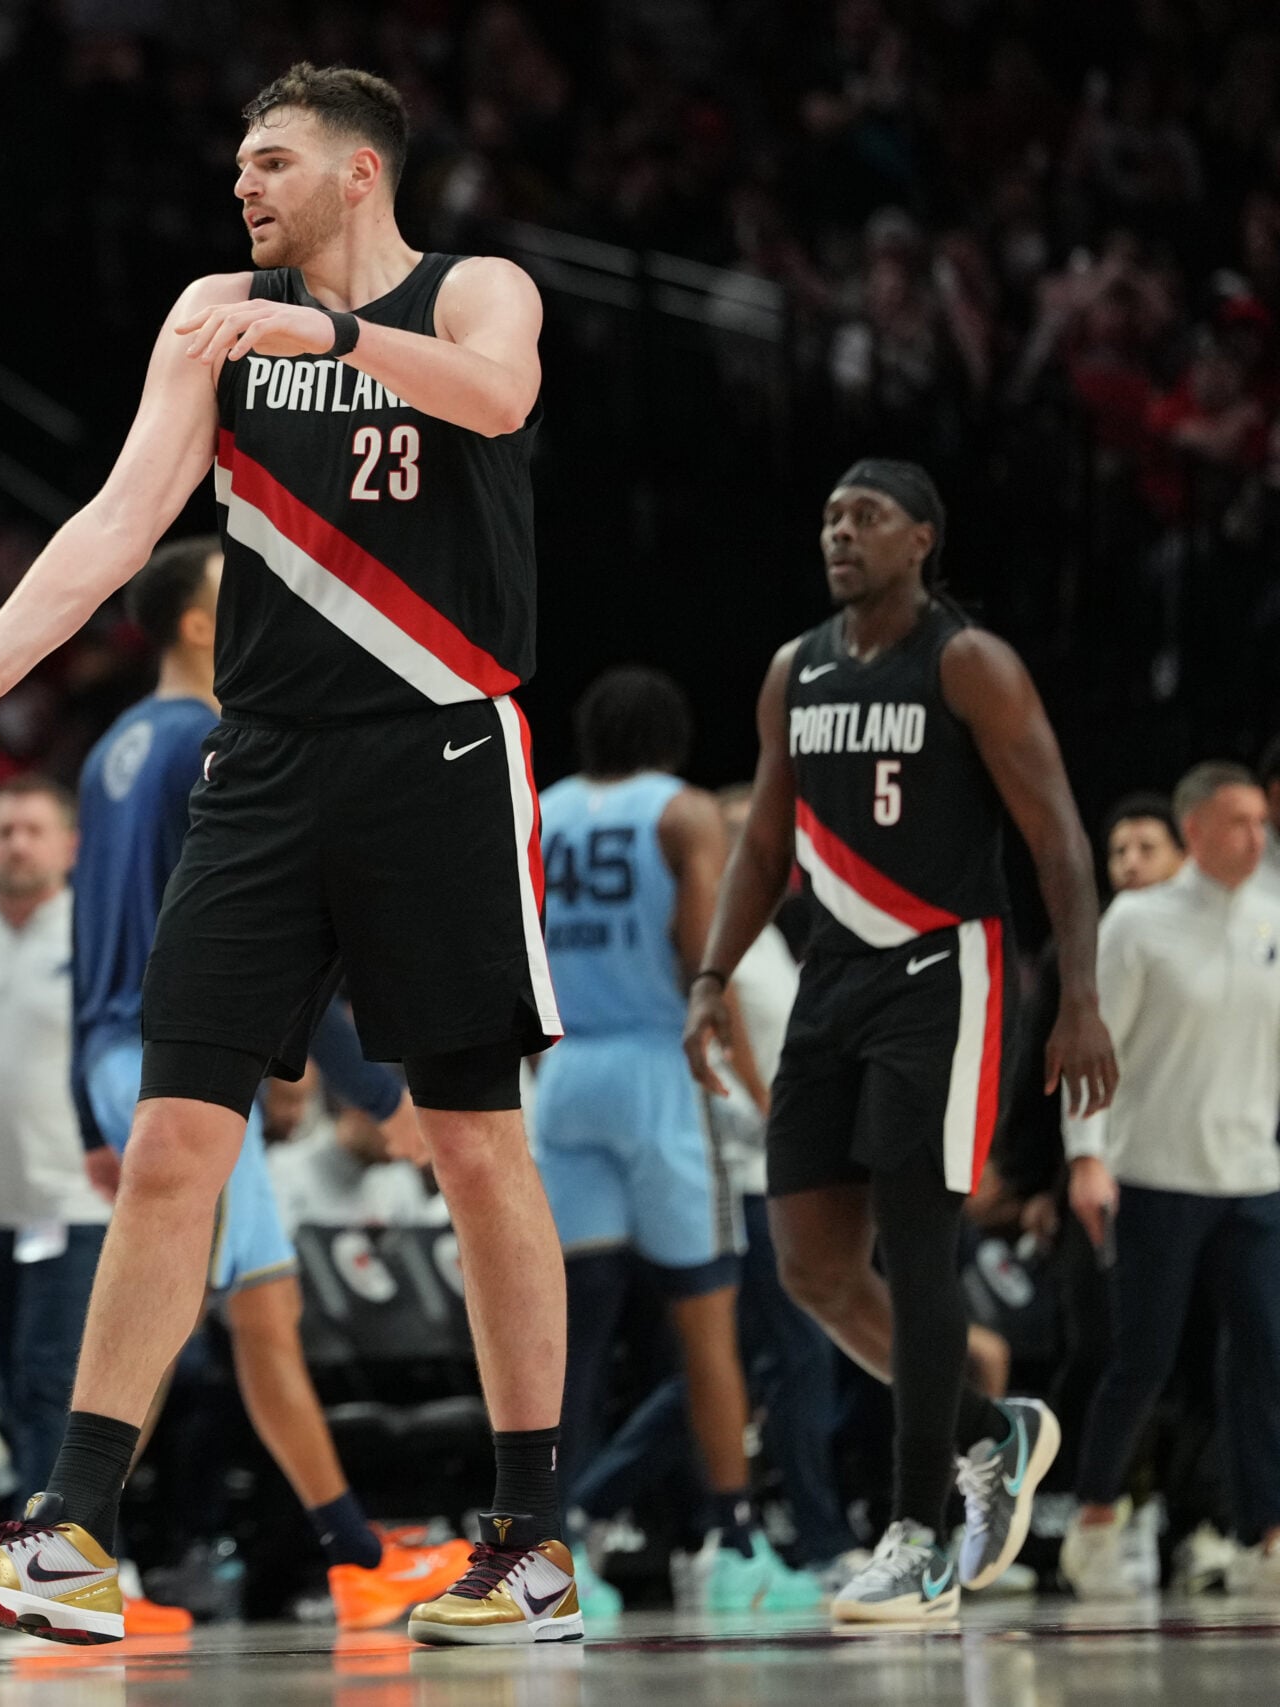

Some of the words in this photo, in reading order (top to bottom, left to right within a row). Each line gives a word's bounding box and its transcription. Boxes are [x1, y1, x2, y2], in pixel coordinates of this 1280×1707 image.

[245, 356, 413, 413] PORTLAN
[350, 423, 421, 501] 23
[789, 702, 927, 758] PORTLAND
[873, 759, 902, 827] 5
[544, 828, 636, 905] 45
